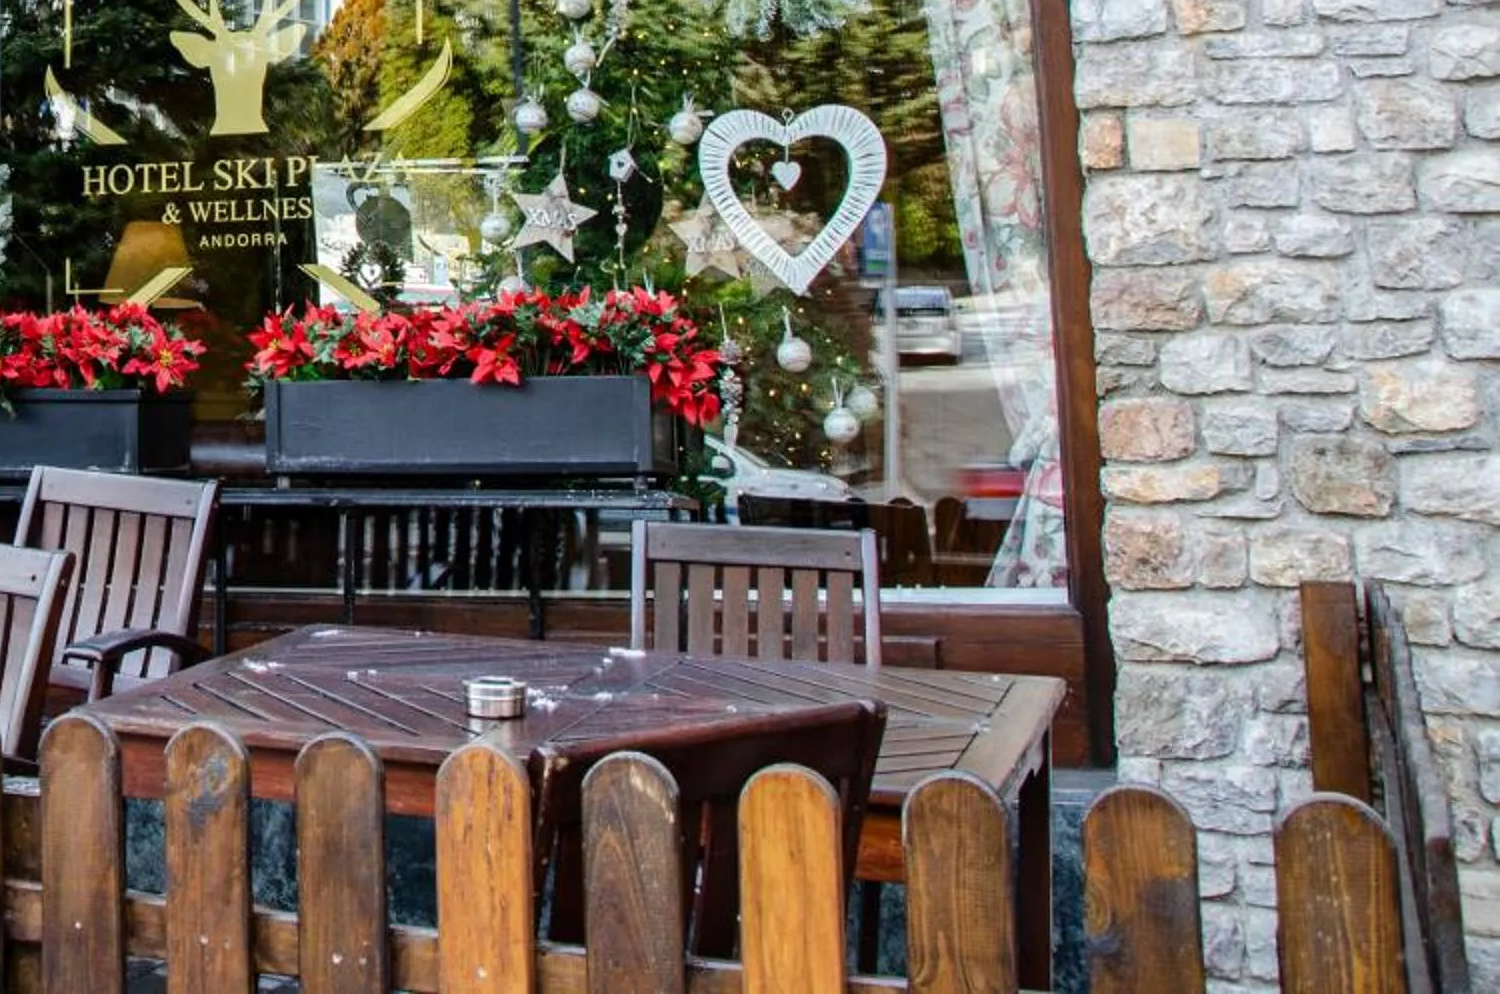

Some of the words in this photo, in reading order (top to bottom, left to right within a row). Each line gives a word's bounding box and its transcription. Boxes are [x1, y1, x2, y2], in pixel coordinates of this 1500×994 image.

[81, 160, 205, 198] HOTEL
[213, 157, 275, 192] SKI
[160, 203, 183, 225] &
[187, 196, 313, 224] WELLNES
[199, 233, 288, 249] ANDORRA
